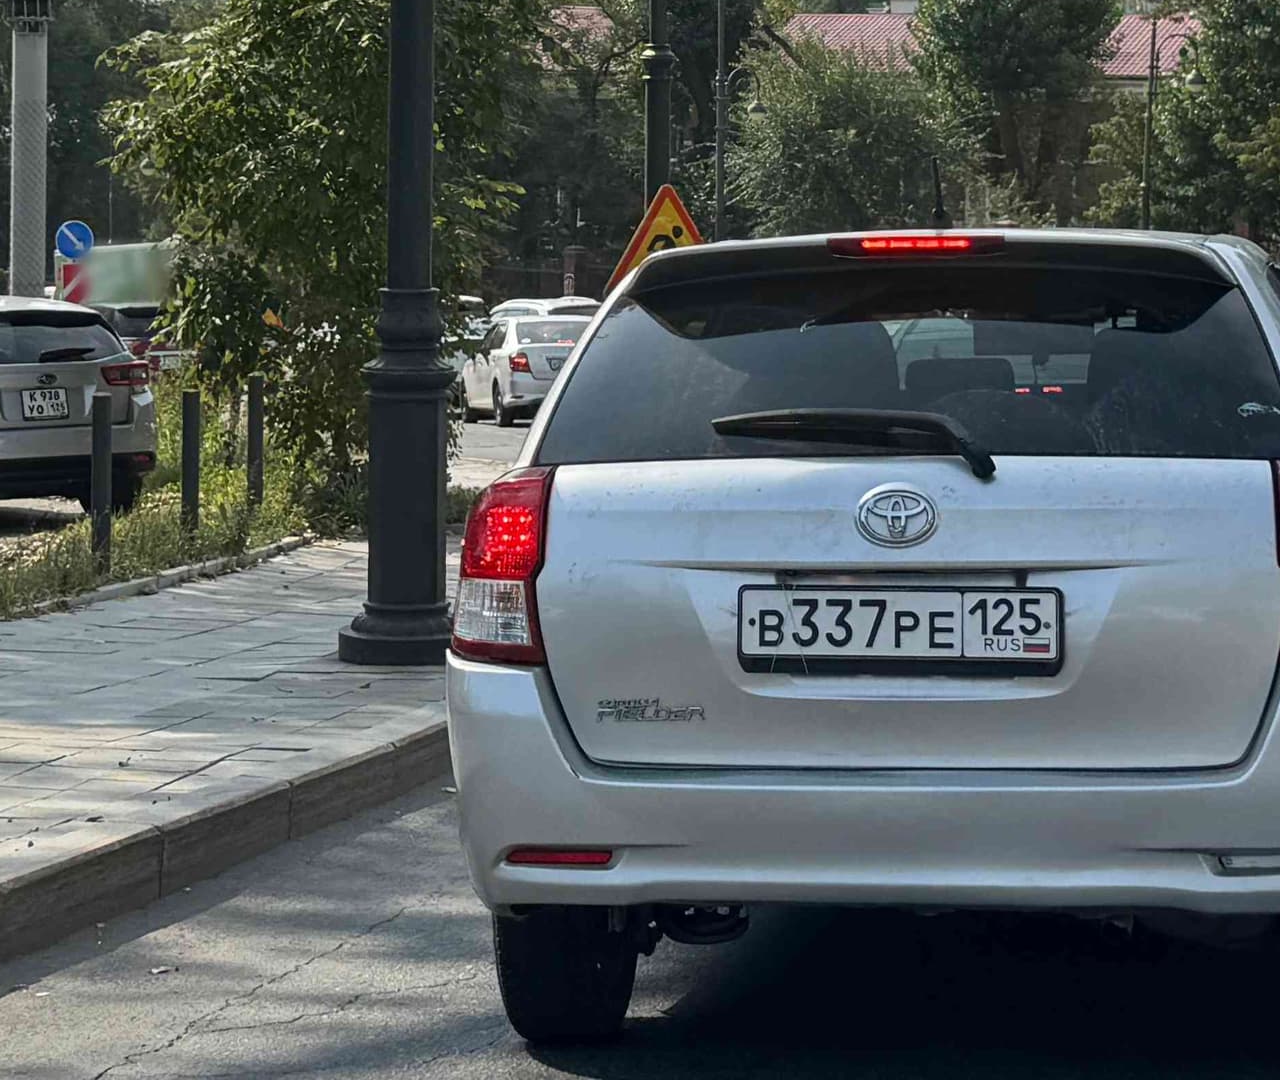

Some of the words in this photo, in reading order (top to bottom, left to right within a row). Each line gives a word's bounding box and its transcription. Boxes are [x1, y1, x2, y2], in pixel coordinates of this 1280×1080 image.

[758, 598, 955, 649] В337РЕ
[968, 598, 1042, 636] 125
[983, 638, 1021, 652] RUS
